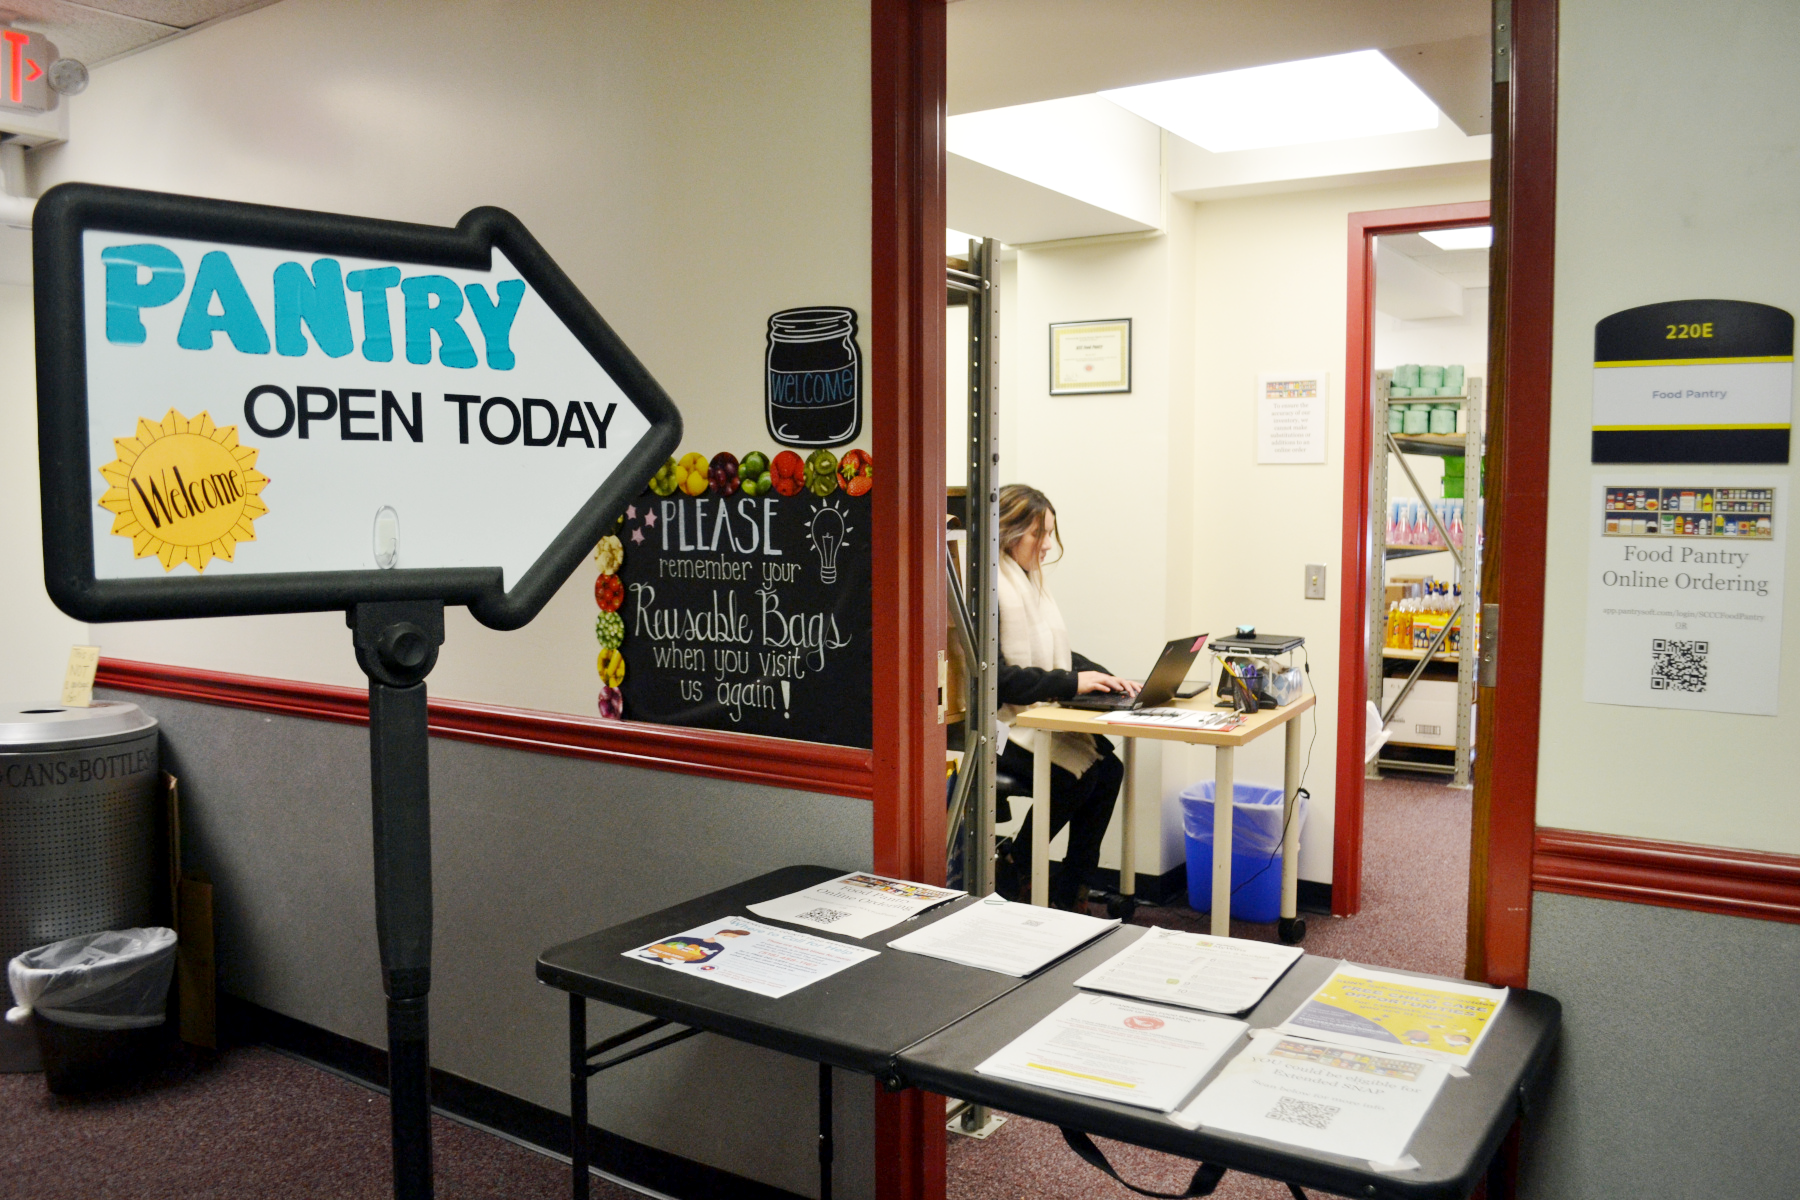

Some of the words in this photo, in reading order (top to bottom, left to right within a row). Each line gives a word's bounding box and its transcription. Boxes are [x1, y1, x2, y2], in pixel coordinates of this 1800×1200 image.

[101, 243, 526, 371] PANTRY
[1665, 322, 1714, 340] 220E
[1652, 390, 1682, 399] Food
[1686, 389, 1728, 400] Pantry
[243, 384, 424, 443] OPEN
[444, 393, 618, 449] TODAY
[130, 464, 245, 529] Welcome
[660, 497, 784, 556] PLEASE
[659, 553, 753, 582] remember
[762, 561, 802, 590] your
[1624, 545, 1673, 563] Food
[1681, 547, 1749, 568] Pantry
[1602, 570, 1669, 588] Online
[1675, 573, 1769, 596] Ordering
[629, 582, 753, 644] Reusable
[755, 588, 852, 672] Bags
[1603, 607, 1765, 622] app.pantrysoft.com/login/SCCCFoodPantry
[653, 644, 706, 672] when
[714, 651, 749, 682] you
[759, 647, 805, 679] visit
[680, 679, 704, 701] us
[717, 680, 792, 723] again!
[6, 761, 68, 788] CANS
[816, 888, 857, 901] Online
[858, 897, 914, 912] Ordering
[840, 885, 873, 896] Food
[874, 892, 911, 904] Pantry
[730, 920, 765, 933] Where
[782, 935, 807, 943] Call
[825, 945, 853, 955] Help
[1341, 985, 1384, 996] FREE
[1388, 992, 1437, 1004] CHILD
[1442, 1001, 1488, 1013] CARE
[1345, 991, 1476, 1018] OPPORTUNITIES
[1273, 1068, 1339, 1088] Extended
[1341, 1083, 1385, 1096] SNAP
[1285, 1061, 1323, 1076] could
[1326, 1070, 1342, 1079] be
[1345, 1074, 1397, 1090] eligible
[1400, 1084, 1422, 1094] for
[1251, 1079, 1277, 1090] Scan
[1279, 1084, 1311, 1098] below
[1331, 1096, 1360, 1105] more
[1362, 1101, 1385, 1111] info
